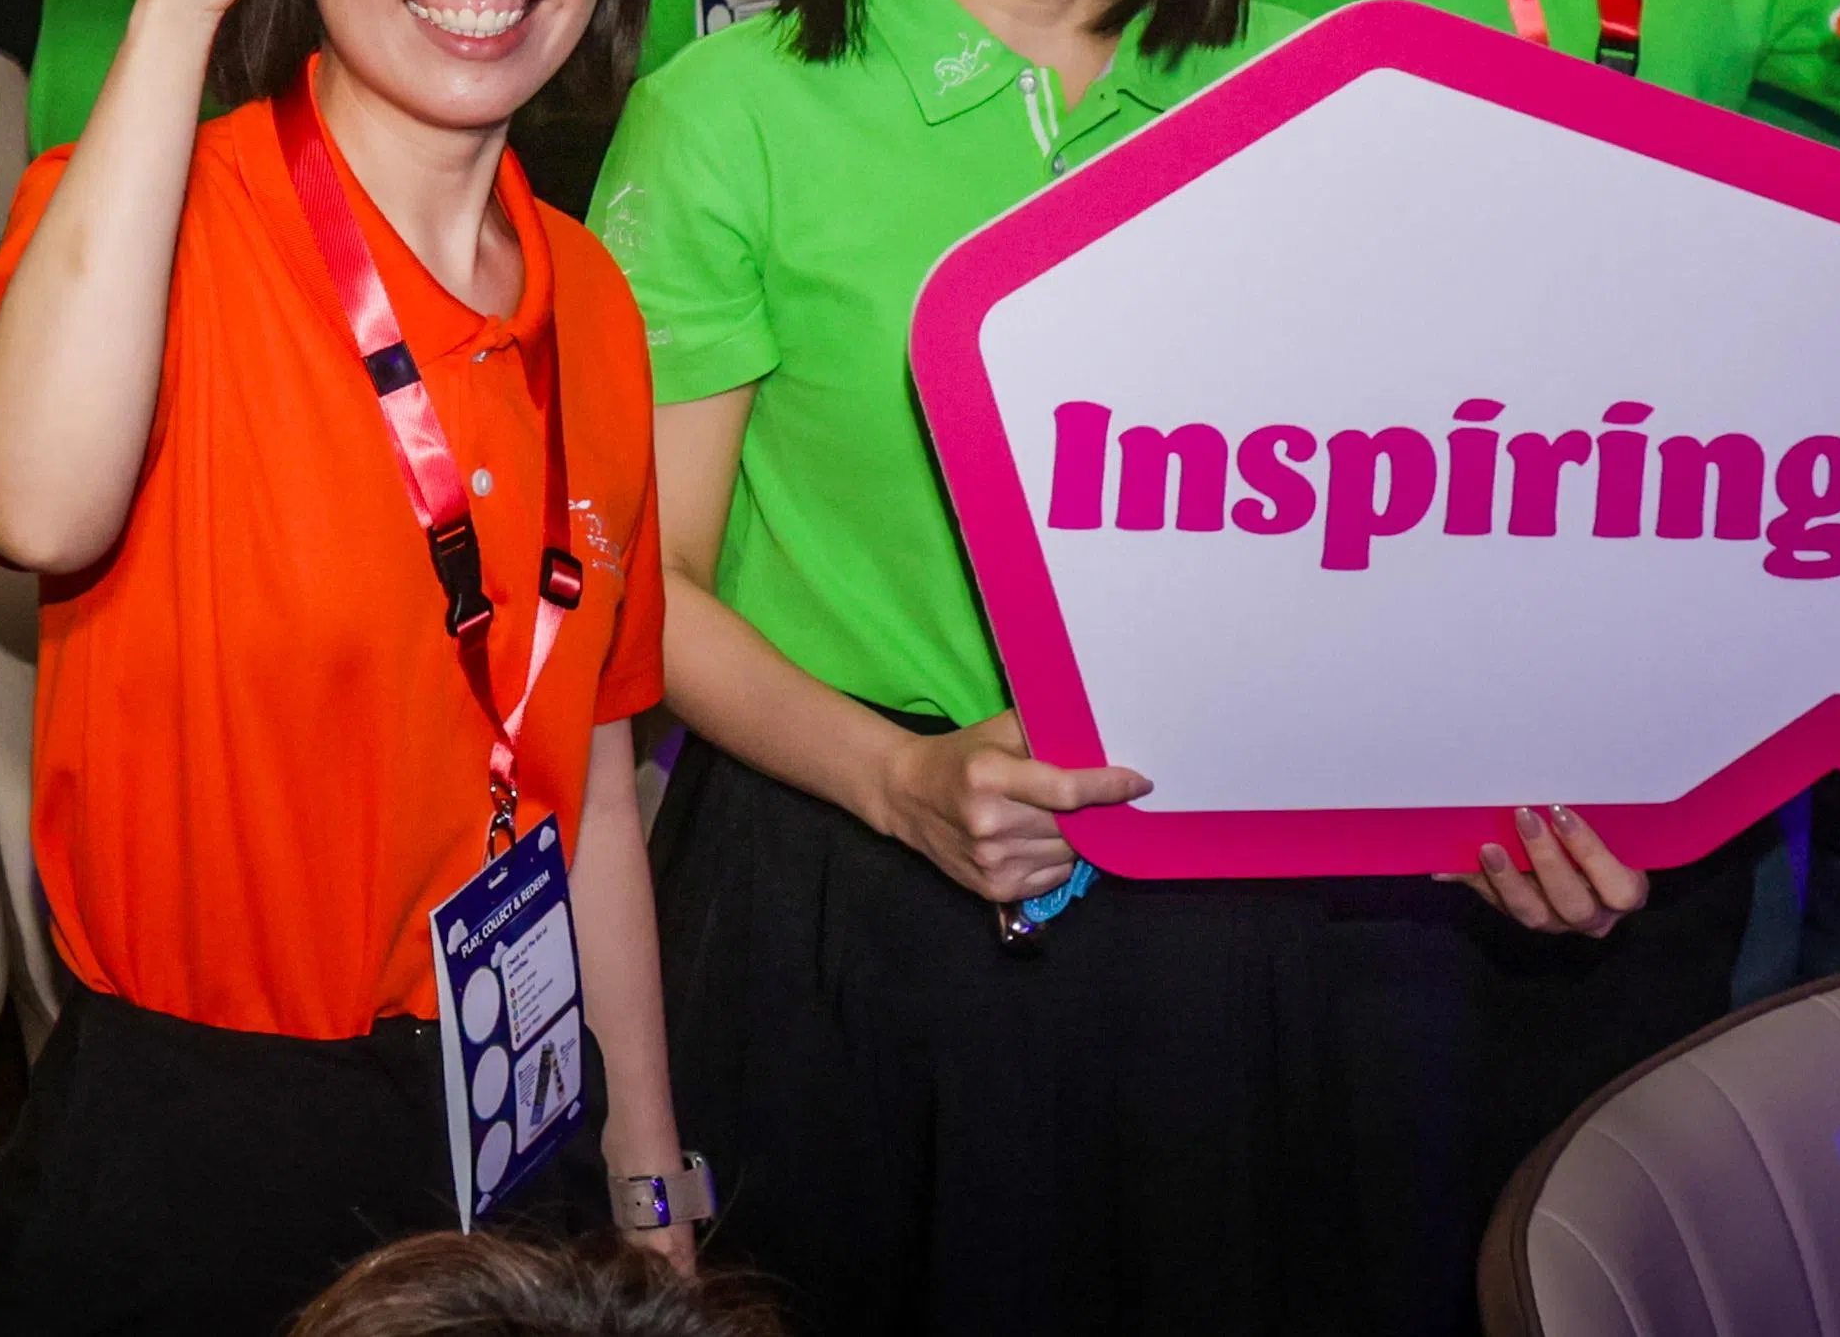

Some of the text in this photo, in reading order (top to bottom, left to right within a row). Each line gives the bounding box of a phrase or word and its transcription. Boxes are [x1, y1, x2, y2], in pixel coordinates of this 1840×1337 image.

[460, 933, 483, 959] PLAY,
[482, 903, 513, 938] COLLECT
[513, 897, 521, 911] &
[520, 869, 551, 902] REDEEM
